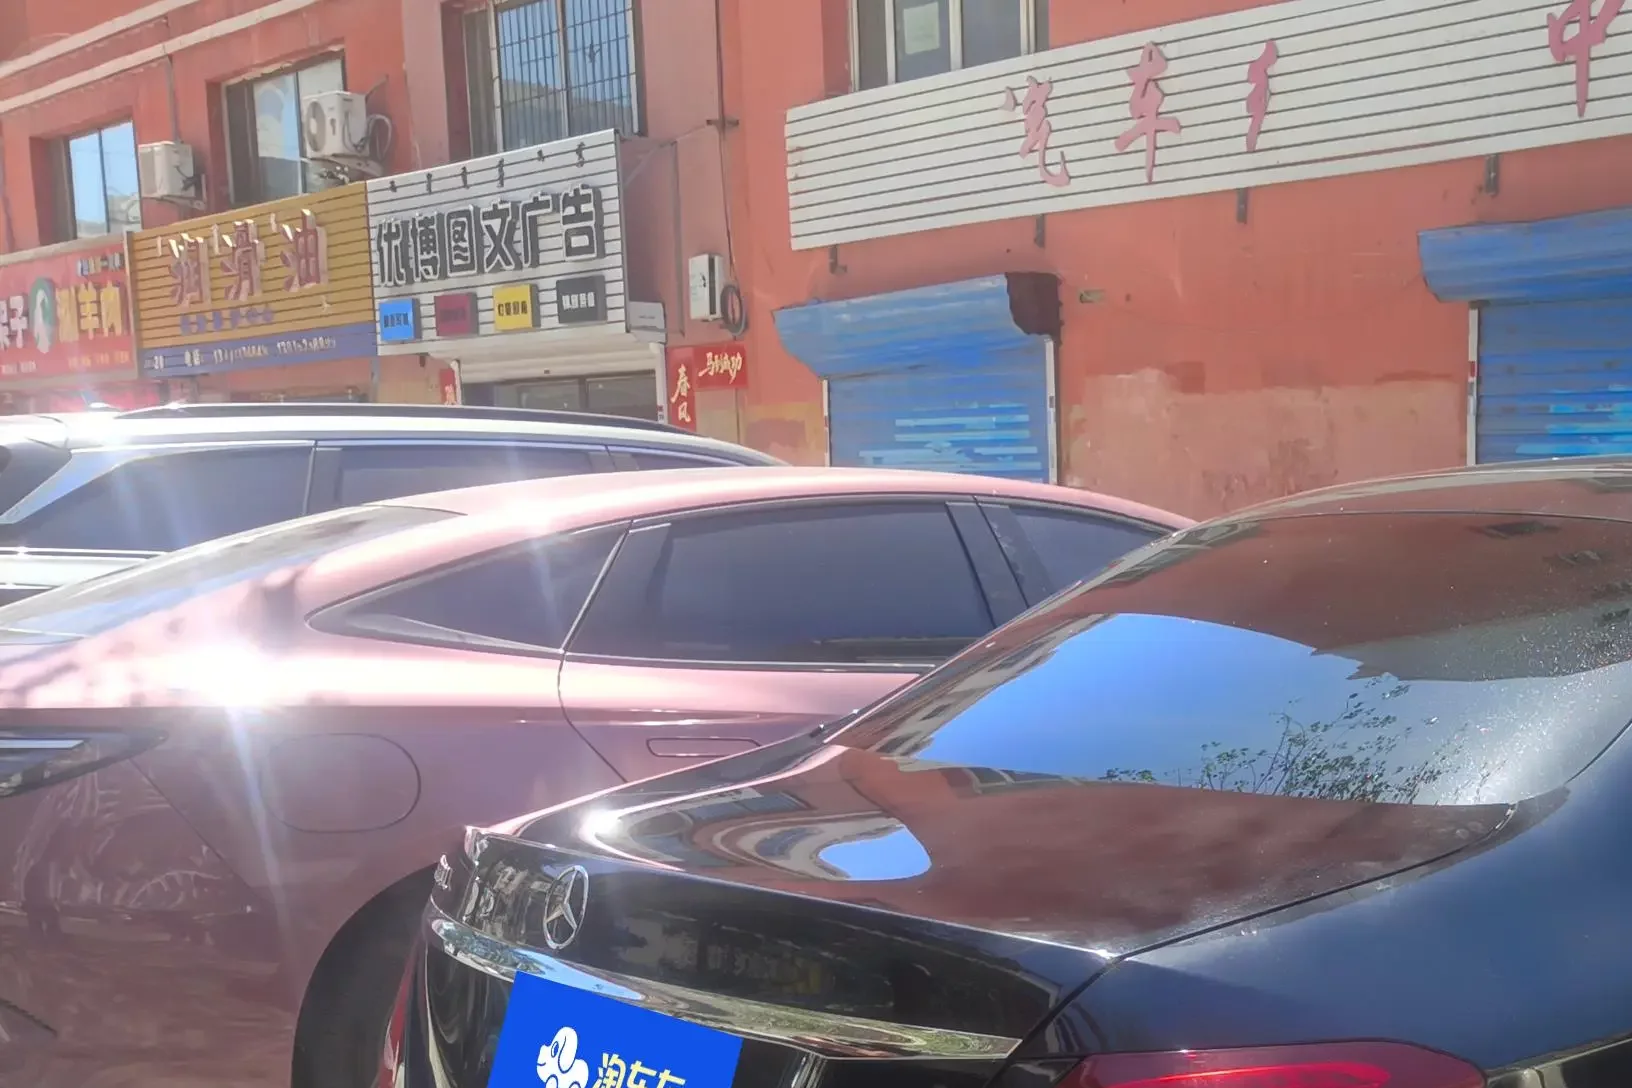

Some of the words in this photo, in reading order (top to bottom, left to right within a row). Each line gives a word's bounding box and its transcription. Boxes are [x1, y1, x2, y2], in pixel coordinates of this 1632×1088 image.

[167, 208, 328, 308] 润滑油
[376, 183, 602, 287] 优博图文广告
